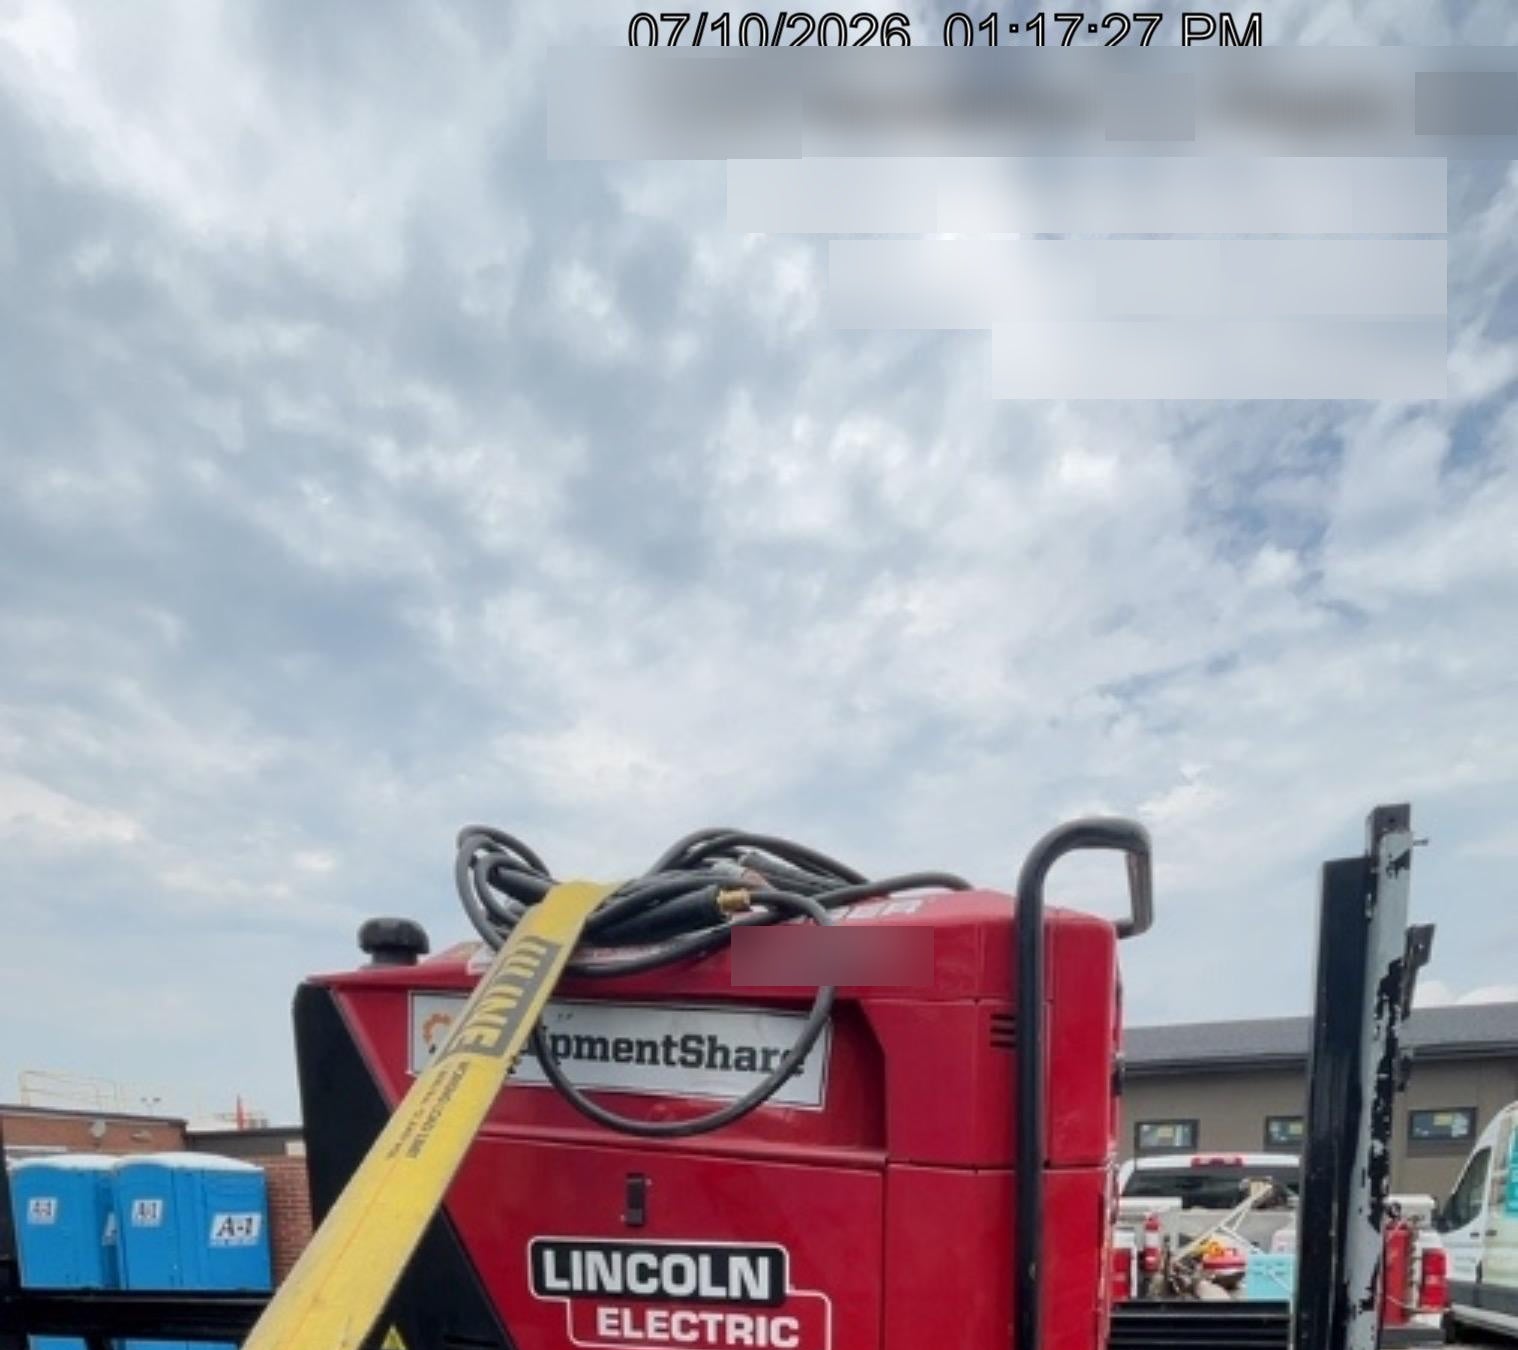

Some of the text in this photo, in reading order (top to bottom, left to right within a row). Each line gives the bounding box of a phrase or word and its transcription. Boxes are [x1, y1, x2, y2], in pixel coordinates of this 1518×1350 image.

[505, 1026, 804, 1075] pmentShar
[216, 1216, 254, 1238] A-1
[542, 1250, 770, 1300] LINCOLN
[596, 1306, 800, 1349] ELECTRIC
